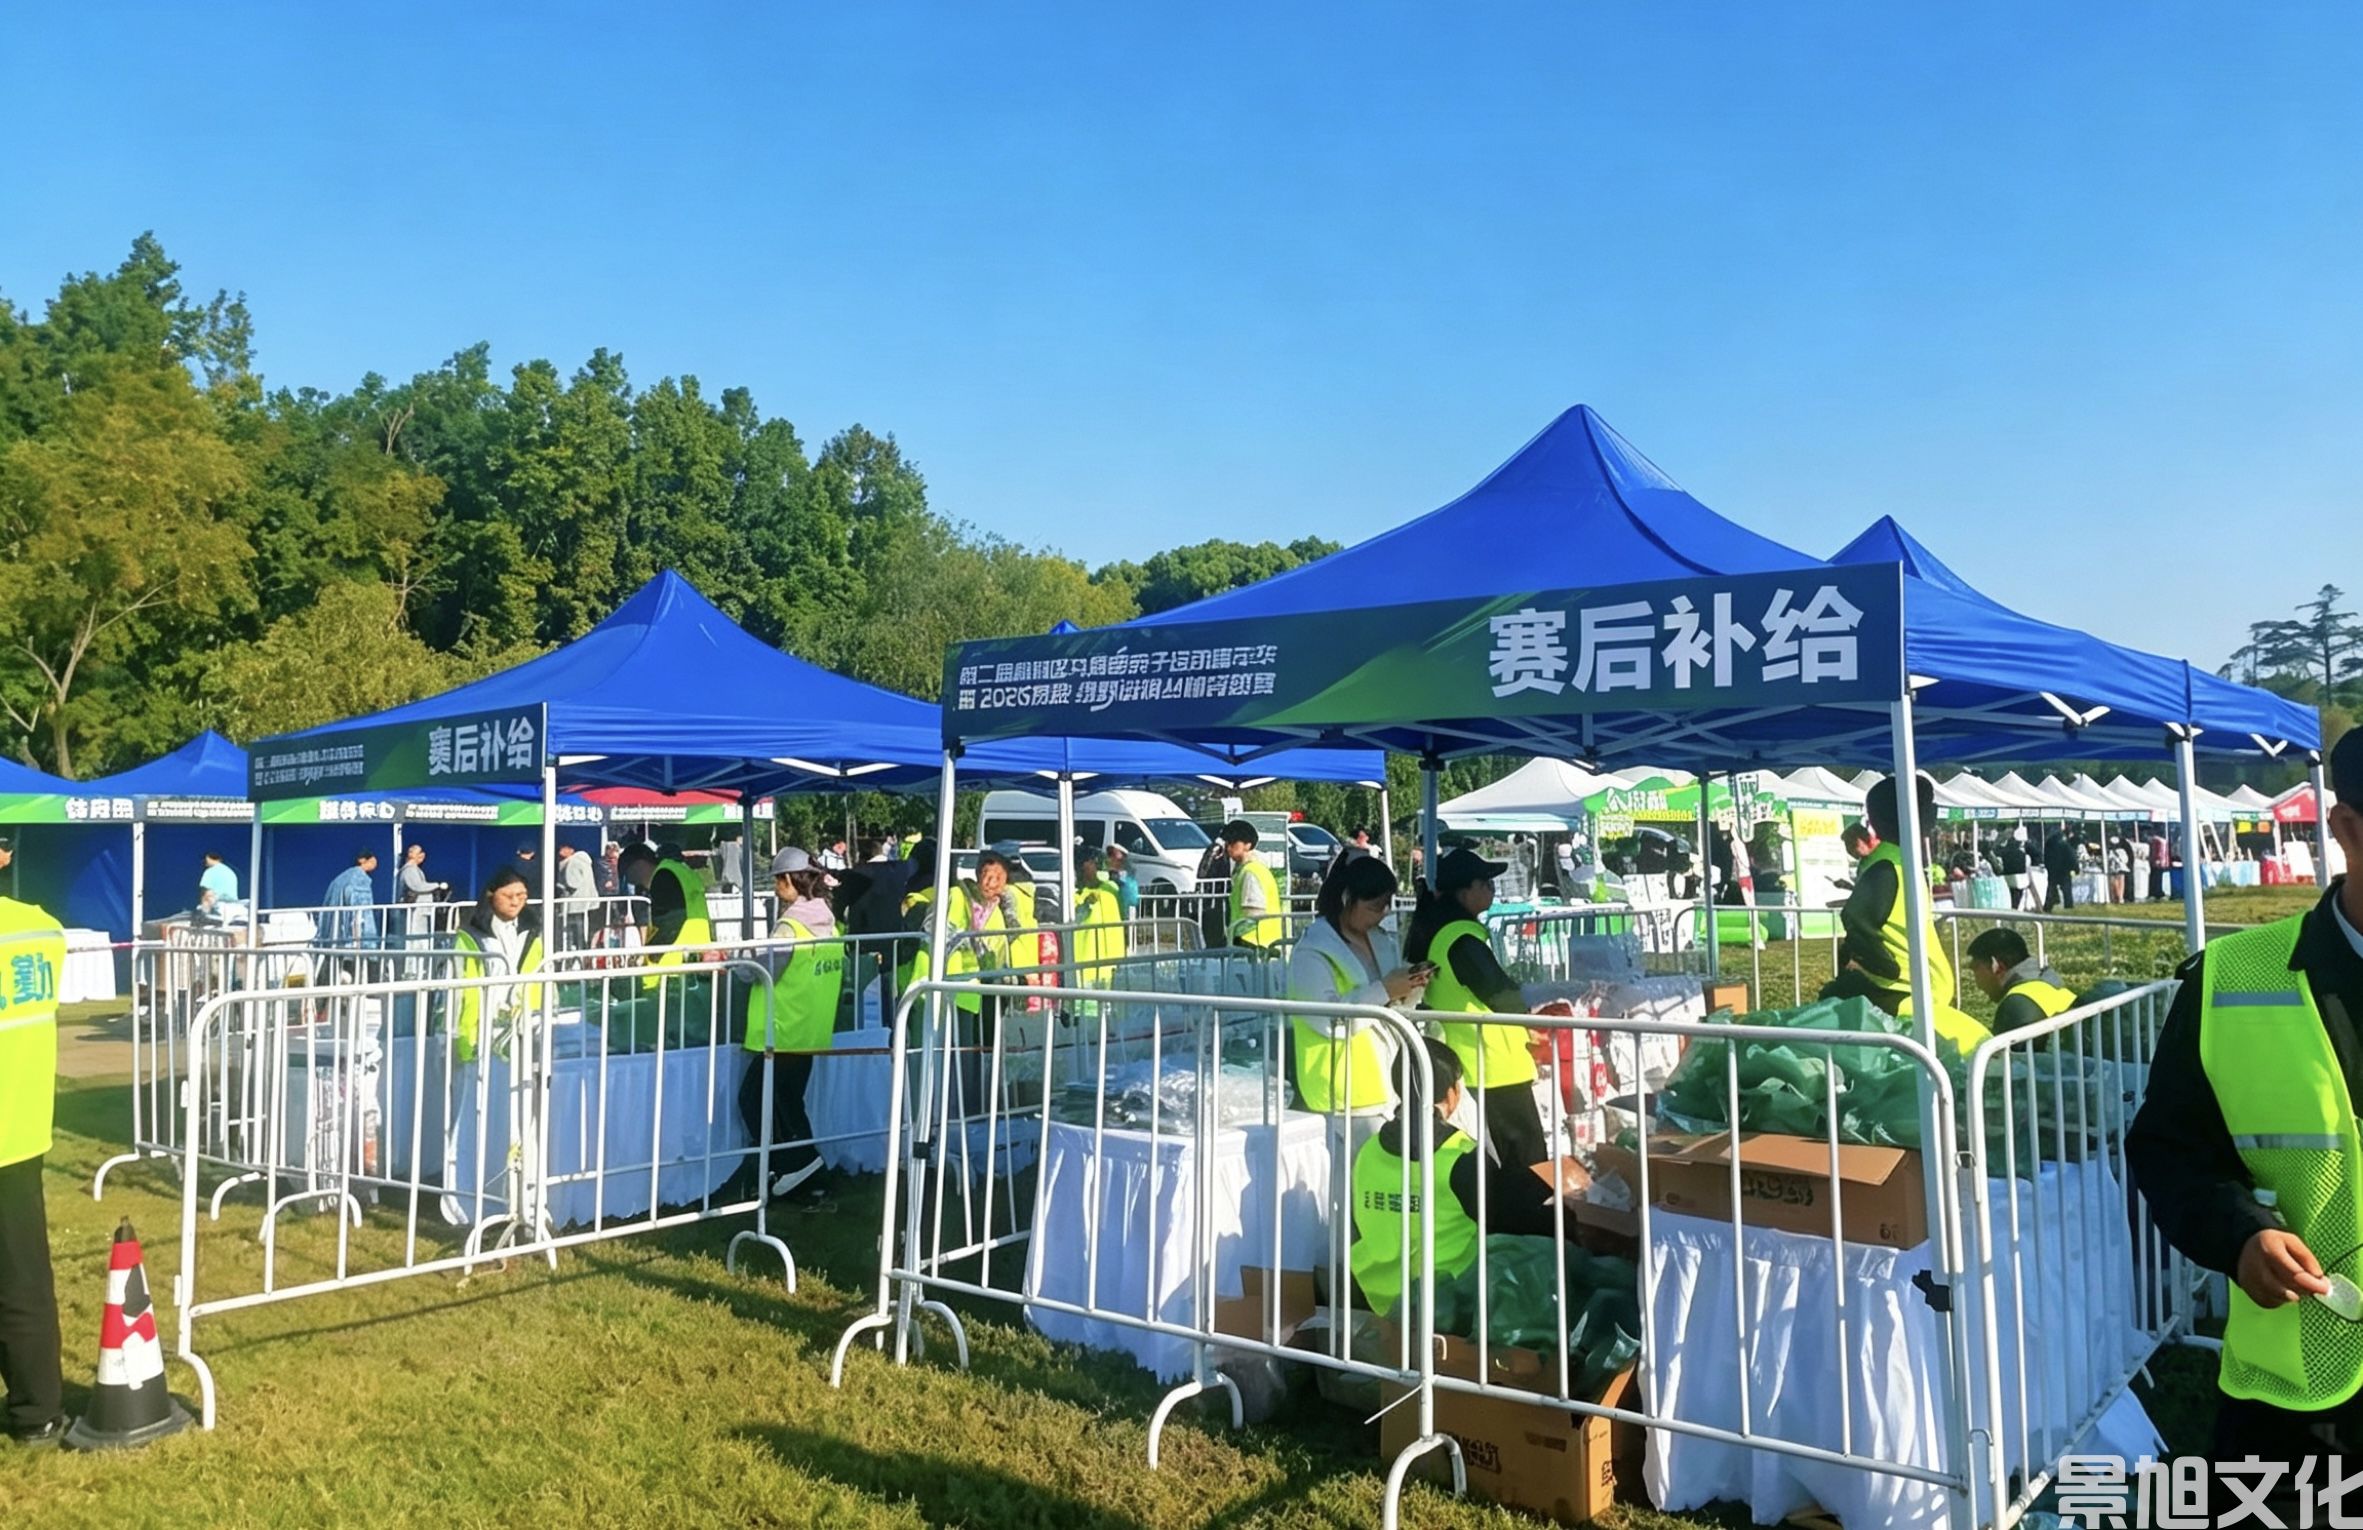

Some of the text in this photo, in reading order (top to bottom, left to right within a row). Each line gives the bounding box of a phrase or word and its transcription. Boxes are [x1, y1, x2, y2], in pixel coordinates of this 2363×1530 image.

[1489, 585, 1864, 698] 赛后补给
[428, 716, 535, 776] 赛后补给
